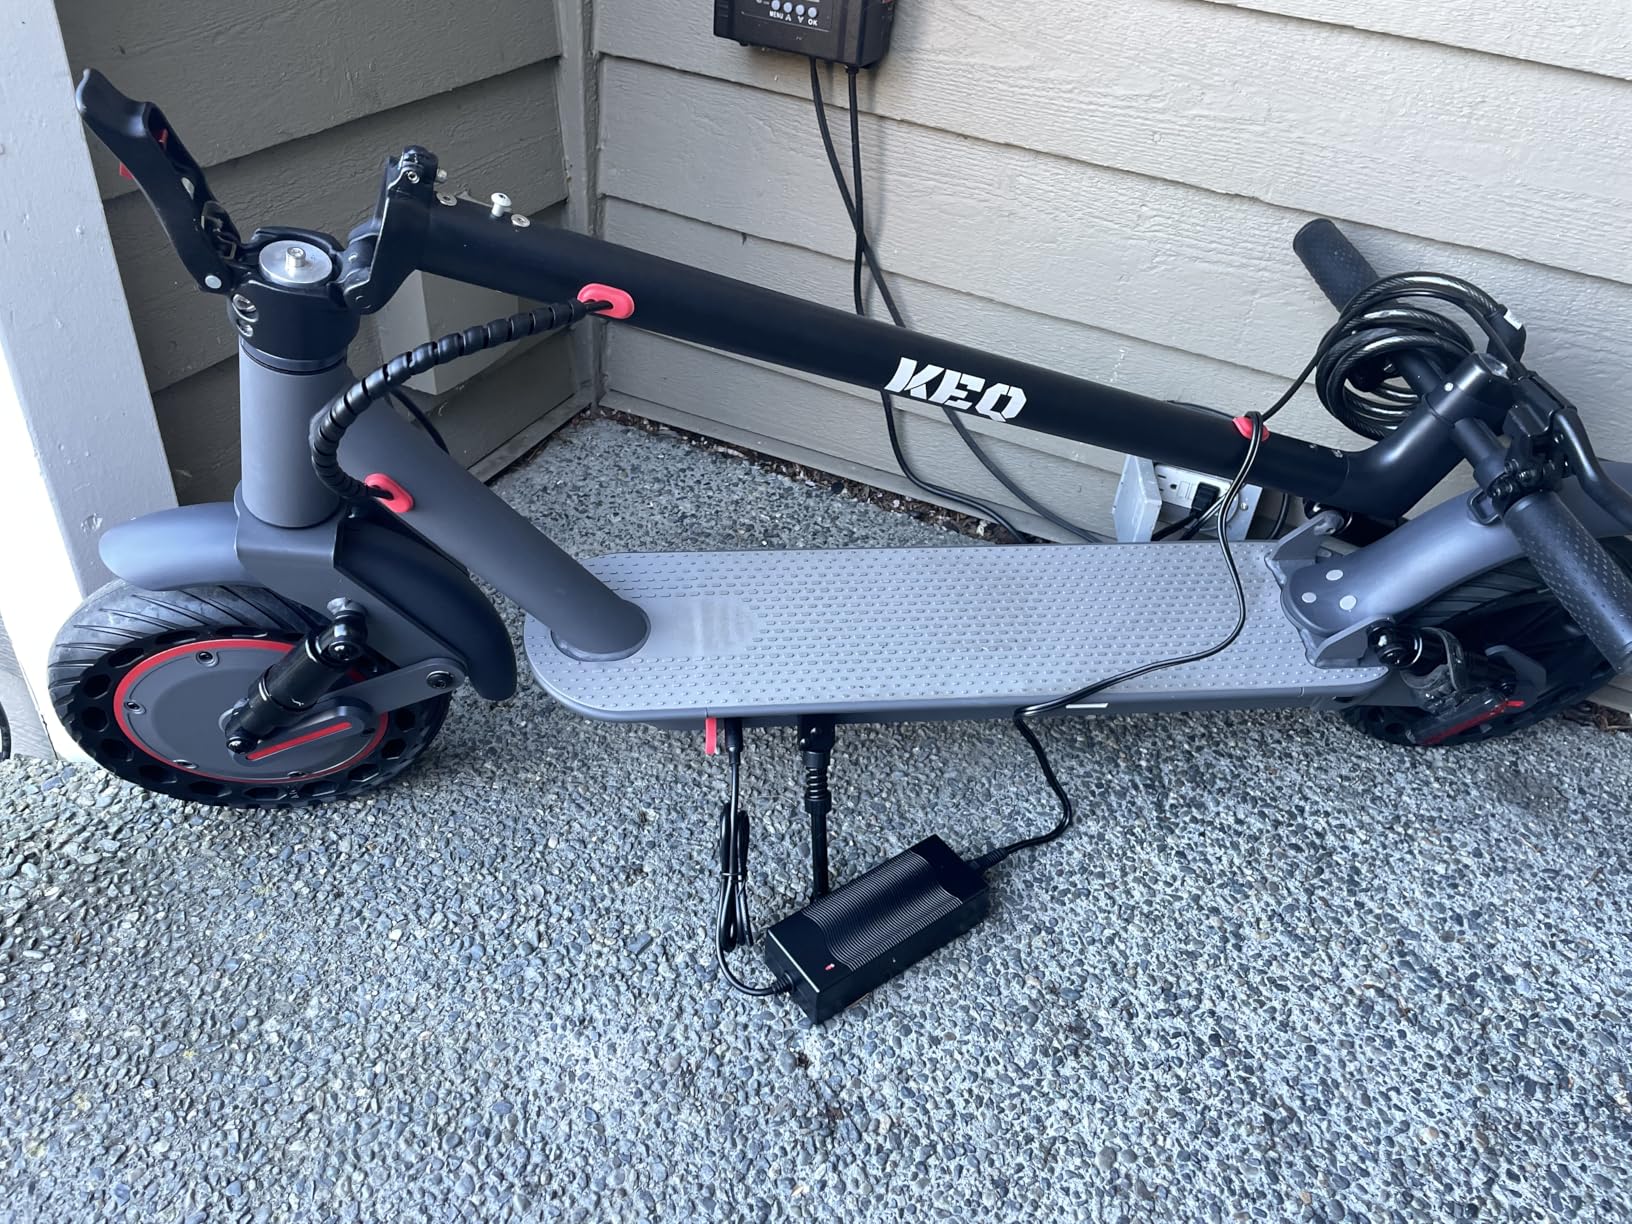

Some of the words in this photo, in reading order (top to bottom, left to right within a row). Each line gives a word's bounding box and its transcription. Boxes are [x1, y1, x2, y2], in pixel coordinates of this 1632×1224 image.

[769, 10, 784, 19] MENU
[807, 18, 818, 26] OK
[884, 357, 1027, 422] KEQ
